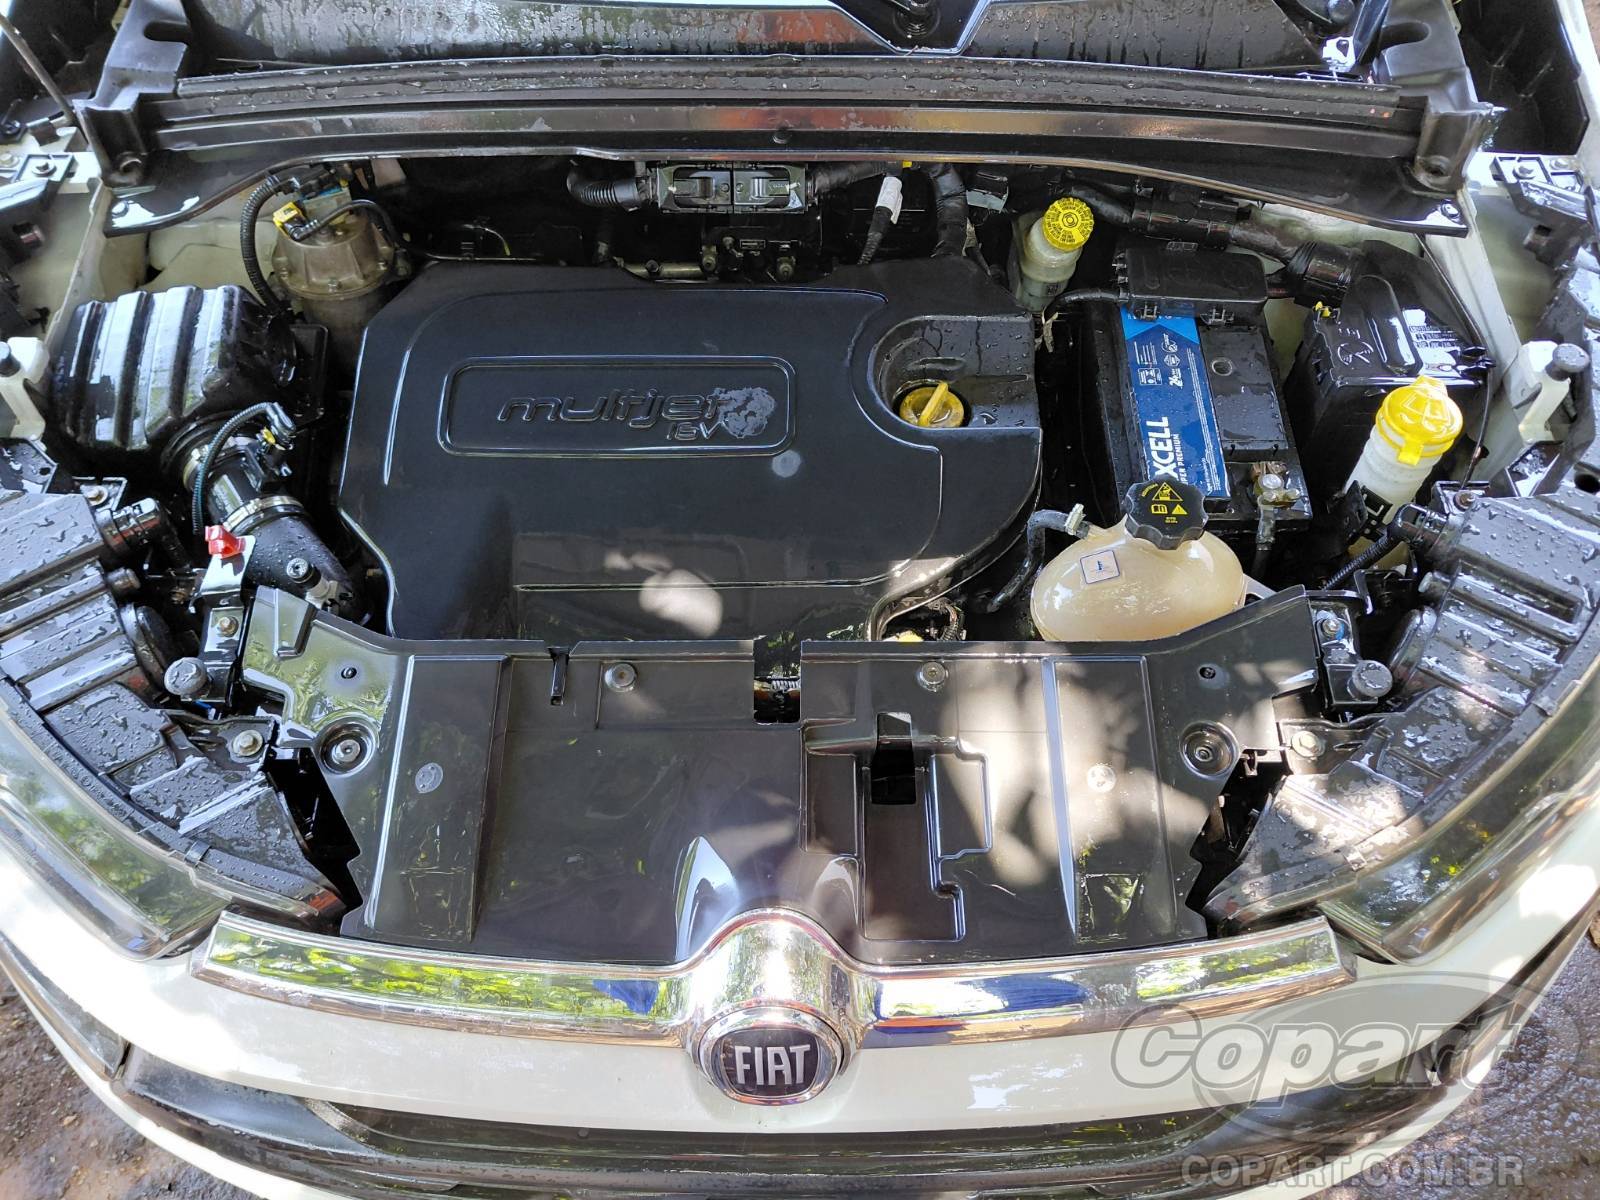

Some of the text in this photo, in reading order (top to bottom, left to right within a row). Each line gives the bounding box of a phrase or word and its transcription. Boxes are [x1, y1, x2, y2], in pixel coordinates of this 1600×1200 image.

[665, 421, 722, 440] 16V
[1172, 433, 1185, 469] PREMIUM
[734, 1044, 811, 1086] FIAT
